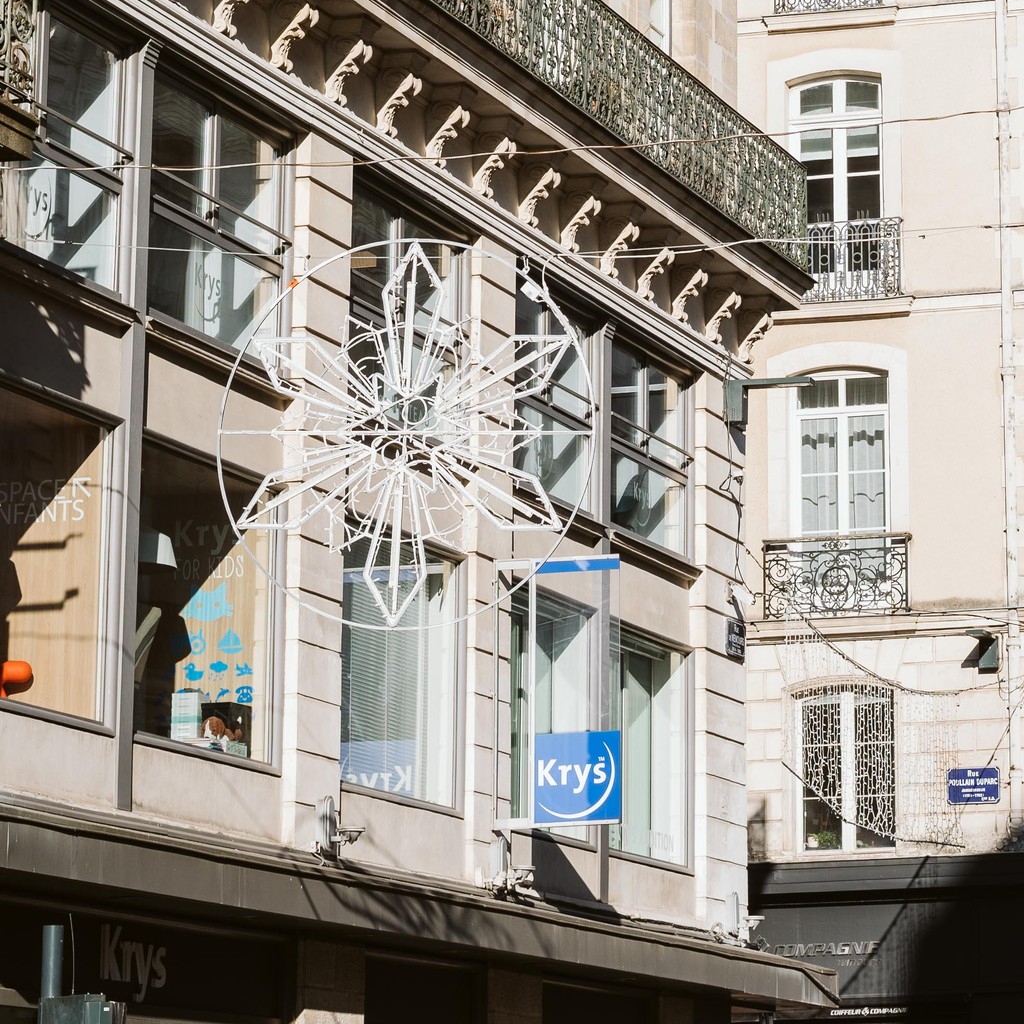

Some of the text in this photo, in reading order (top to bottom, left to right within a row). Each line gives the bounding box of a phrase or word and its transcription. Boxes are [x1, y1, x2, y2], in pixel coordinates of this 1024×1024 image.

[174, 555, 244, 581] FOR KIDS
[537, 758, 607, 794] Krys
[976, 777, 998, 786] DUPARC
[774, 940, 881, 958] COMPAGNIE
[100, 922, 167, 1003] Krys
[830, 1008, 862, 1016] COIFFEUR
